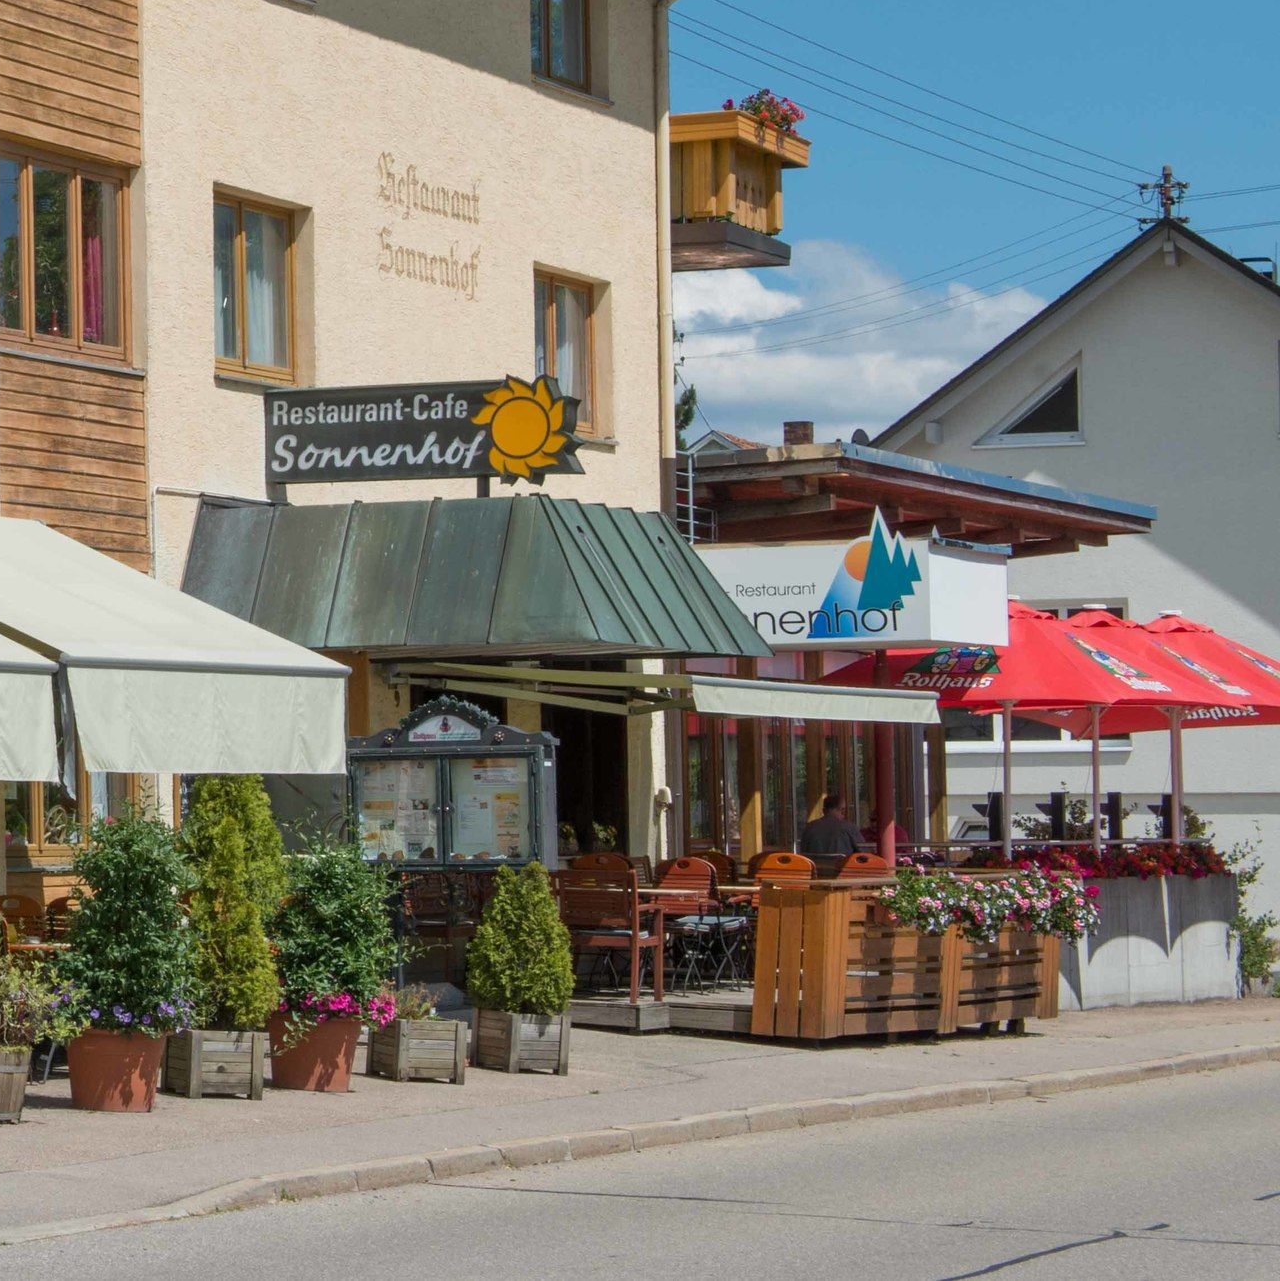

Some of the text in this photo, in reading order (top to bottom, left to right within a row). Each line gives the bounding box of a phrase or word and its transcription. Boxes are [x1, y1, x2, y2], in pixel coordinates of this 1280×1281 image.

[376, 226, 482, 303] Sonnenhof
[272, 393, 468, 427] Restaurant-Cafe
[271, 429, 486, 473] Sonnenhof
[735, 582, 817, 598] Restaurant
[745, 600, 901, 636] nenhof
[895, 672, 994, 690] Rothaus
